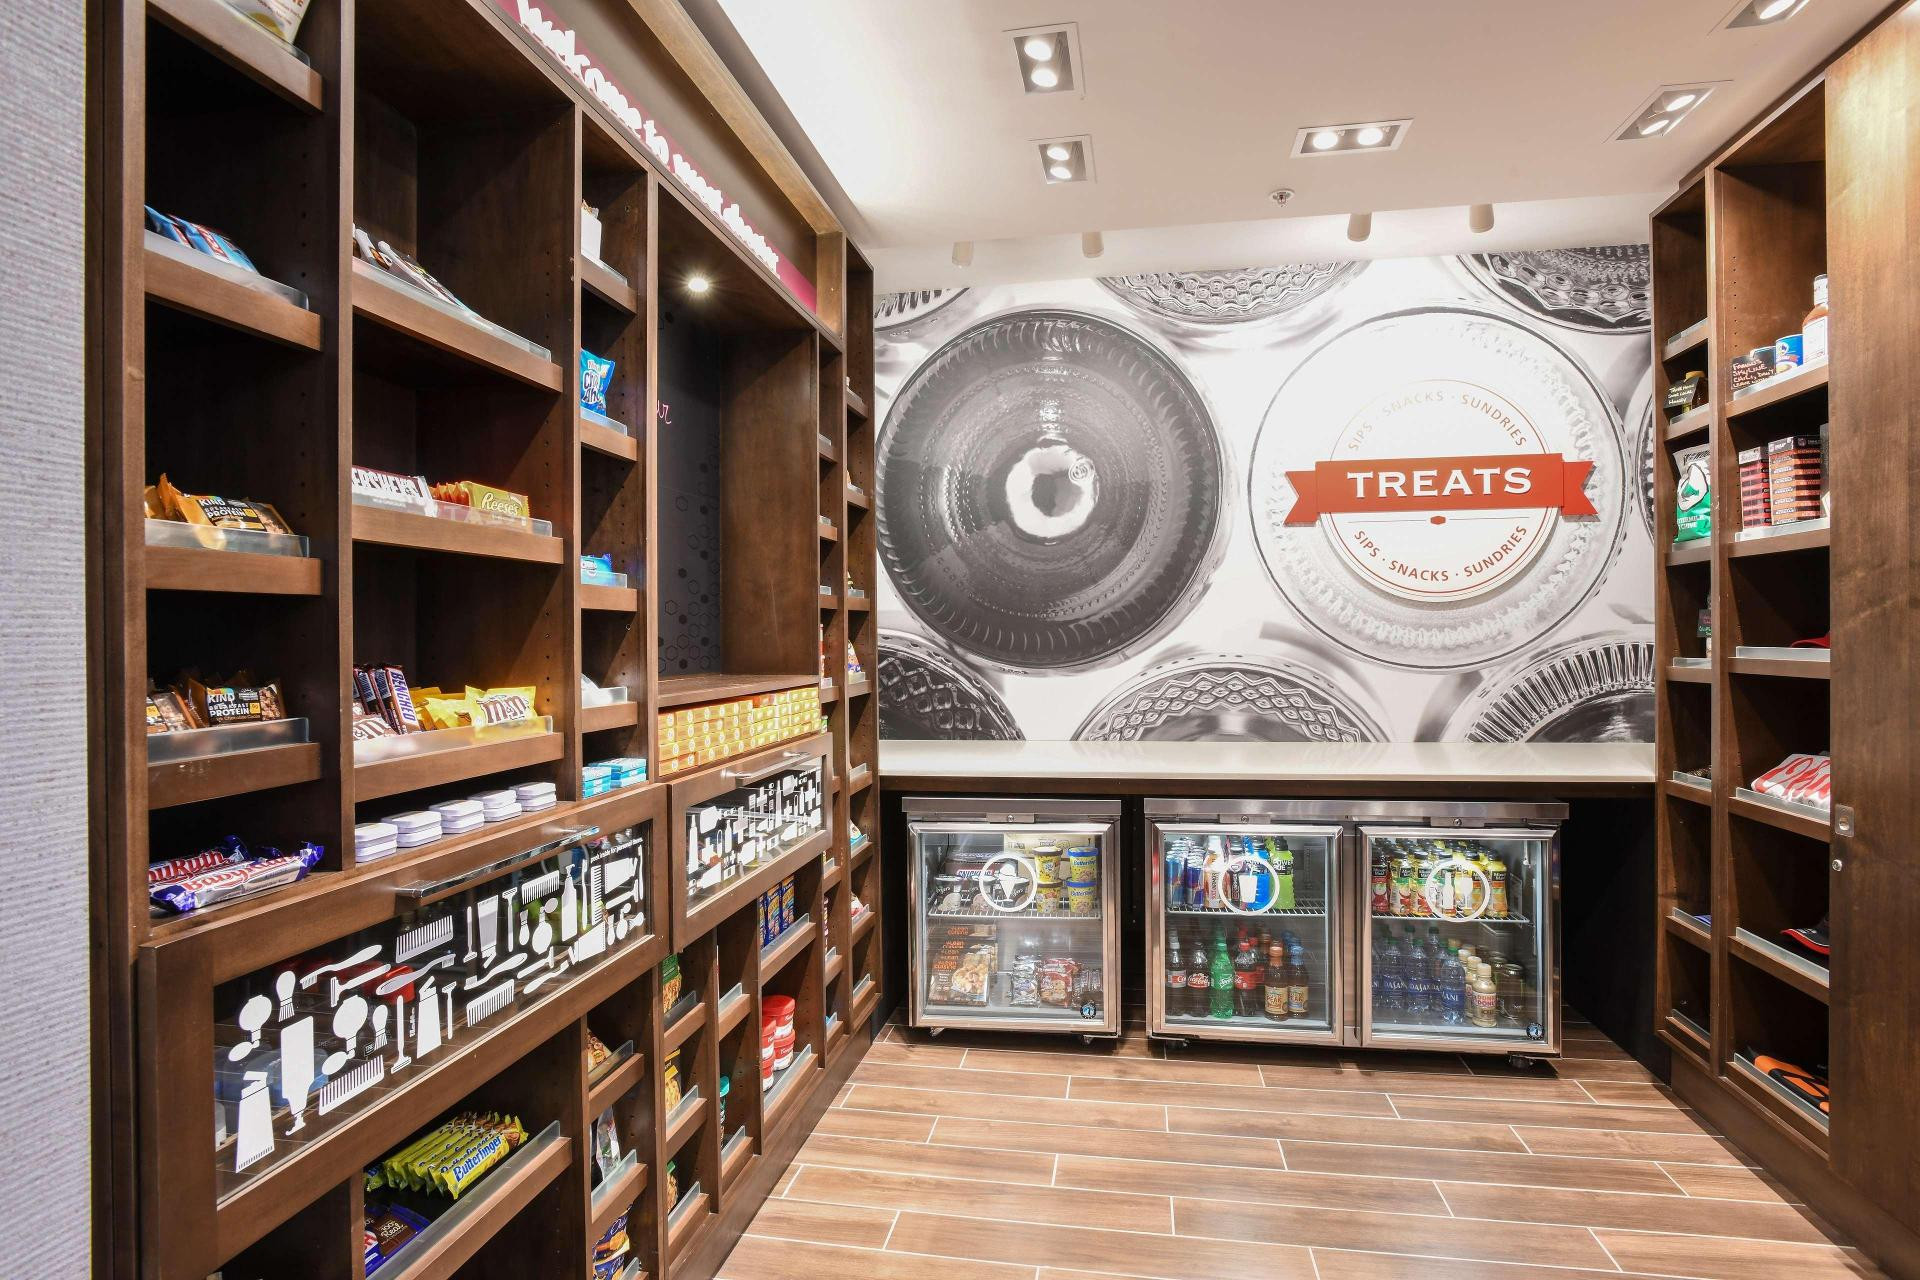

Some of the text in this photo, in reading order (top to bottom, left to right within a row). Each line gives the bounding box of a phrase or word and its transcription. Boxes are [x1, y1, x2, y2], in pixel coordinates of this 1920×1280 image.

[1348, 391, 1527, 451] SIPS SNACKS SUNDRIES
[1347, 467, 1532, 498] TREATS
[482, 492, 519, 516] Reese's
[1354, 526, 1527, 582] SIPS SNACKS SUNDRIES
[207, 693, 235, 703] KIND
[210, 708, 250, 718] PROTEIN
[391, 671, 416, 721] BENCHED
[453, 1136, 502, 1182] Butterfinger
